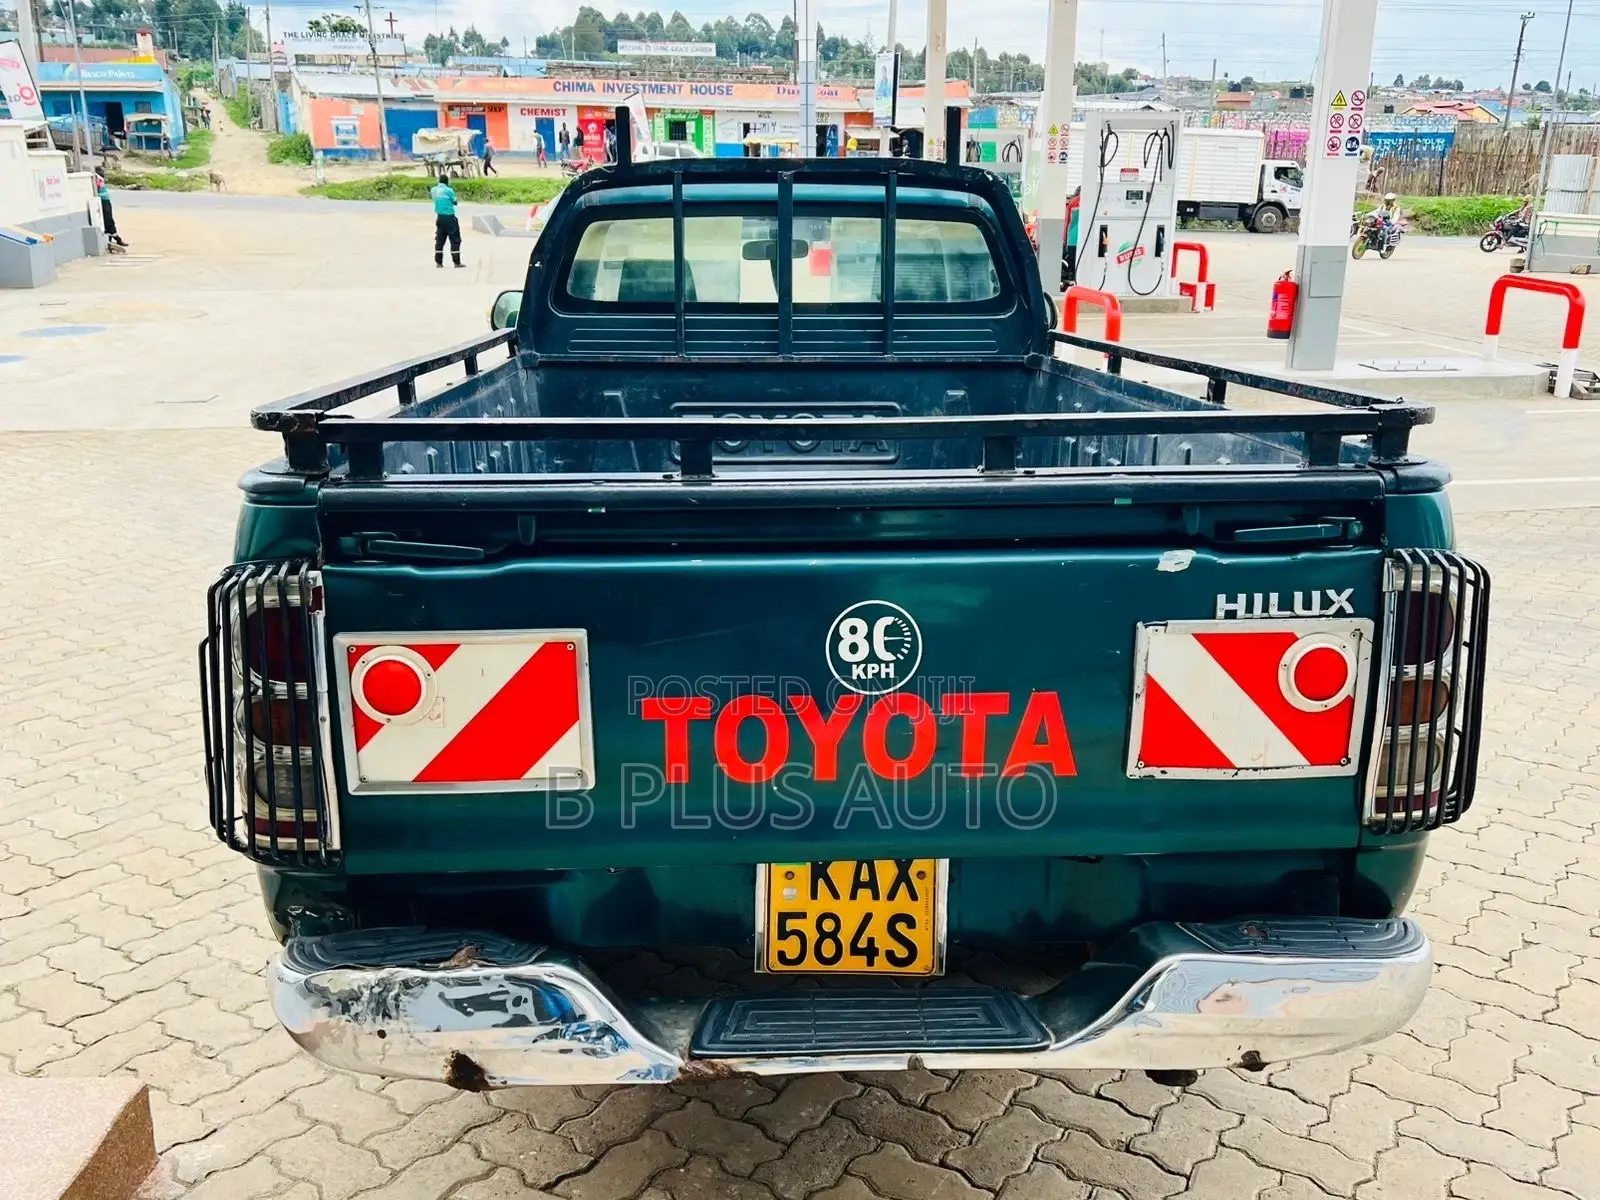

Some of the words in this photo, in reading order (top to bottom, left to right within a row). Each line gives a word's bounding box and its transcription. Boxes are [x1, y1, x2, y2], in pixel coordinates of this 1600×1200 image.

[283, 31, 299, 39] THE
[301, 31, 327, 39] LIVING
[330, 31, 357, 39] GRACE
[553, 81, 595, 92] CHIMA
[602, 83, 684, 95] INVESTMENT
[690, 84, 733, 96] HOUSE
[520, 107, 568, 117] CHEMIST
[1215, 588, 1355, 619] HILUX
[838, 616, 912, 662] 80
[851, 663, 895, 680] KPH
[641, 691, 1079, 785] TOYOTA
[809, 859, 920, 902] KAX
[777, 912, 918, 968] 584S
